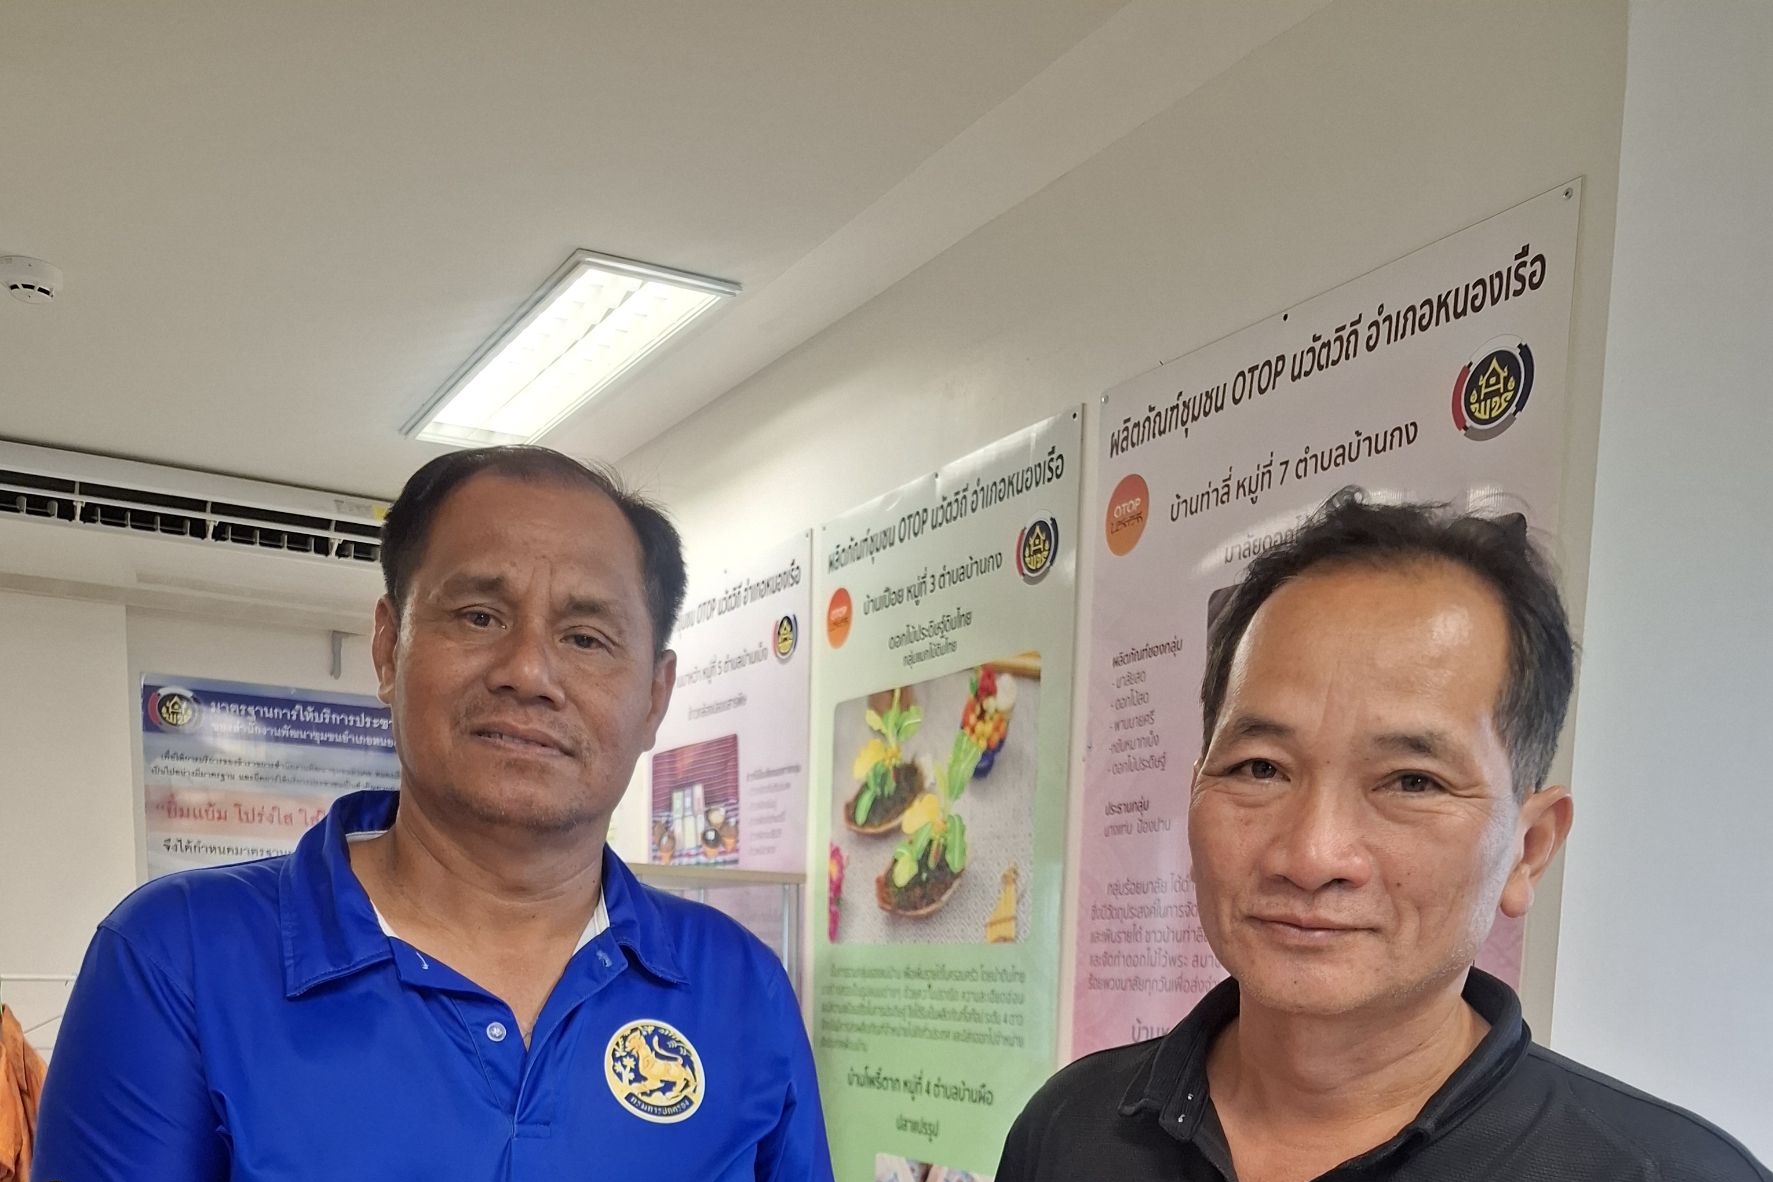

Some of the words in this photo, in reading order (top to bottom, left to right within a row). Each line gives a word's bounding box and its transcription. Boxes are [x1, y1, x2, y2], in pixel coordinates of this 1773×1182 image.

[1109, 381, 1227, 460] ผลิตภัณฑ์ชุมชน
[1231, 354, 1287, 406] OTOP
[1289, 313, 1363, 383] นวัตวิถี
[1365, 242, 1547, 354] อำเภอหนองเรือ
[828, 524, 895, 574] ผลิตภัณฑ์ชุมชน
[898, 508, 929, 544] OTOP
[931, 483, 968, 531] นวัตวิถี
[970, 446, 1065, 514] อำเภอหนองเรือ
[1114, 497, 1141, 518] OTOP
[1170, 467, 1233, 522] บ้านท่าลี่
[1235, 451, 1275, 505] หมู่ที่
[1278, 461, 1290, 488] 7
[1294, 420, 1418, 481] ตำบลบ้านกง
[696, 597, 716, 625] OTOP
[906, 567, 927, 606] หมู่ที่
[929, 577, 937, 594] 3
[938, 552, 1003, 590] ตำบลบ้านกง
